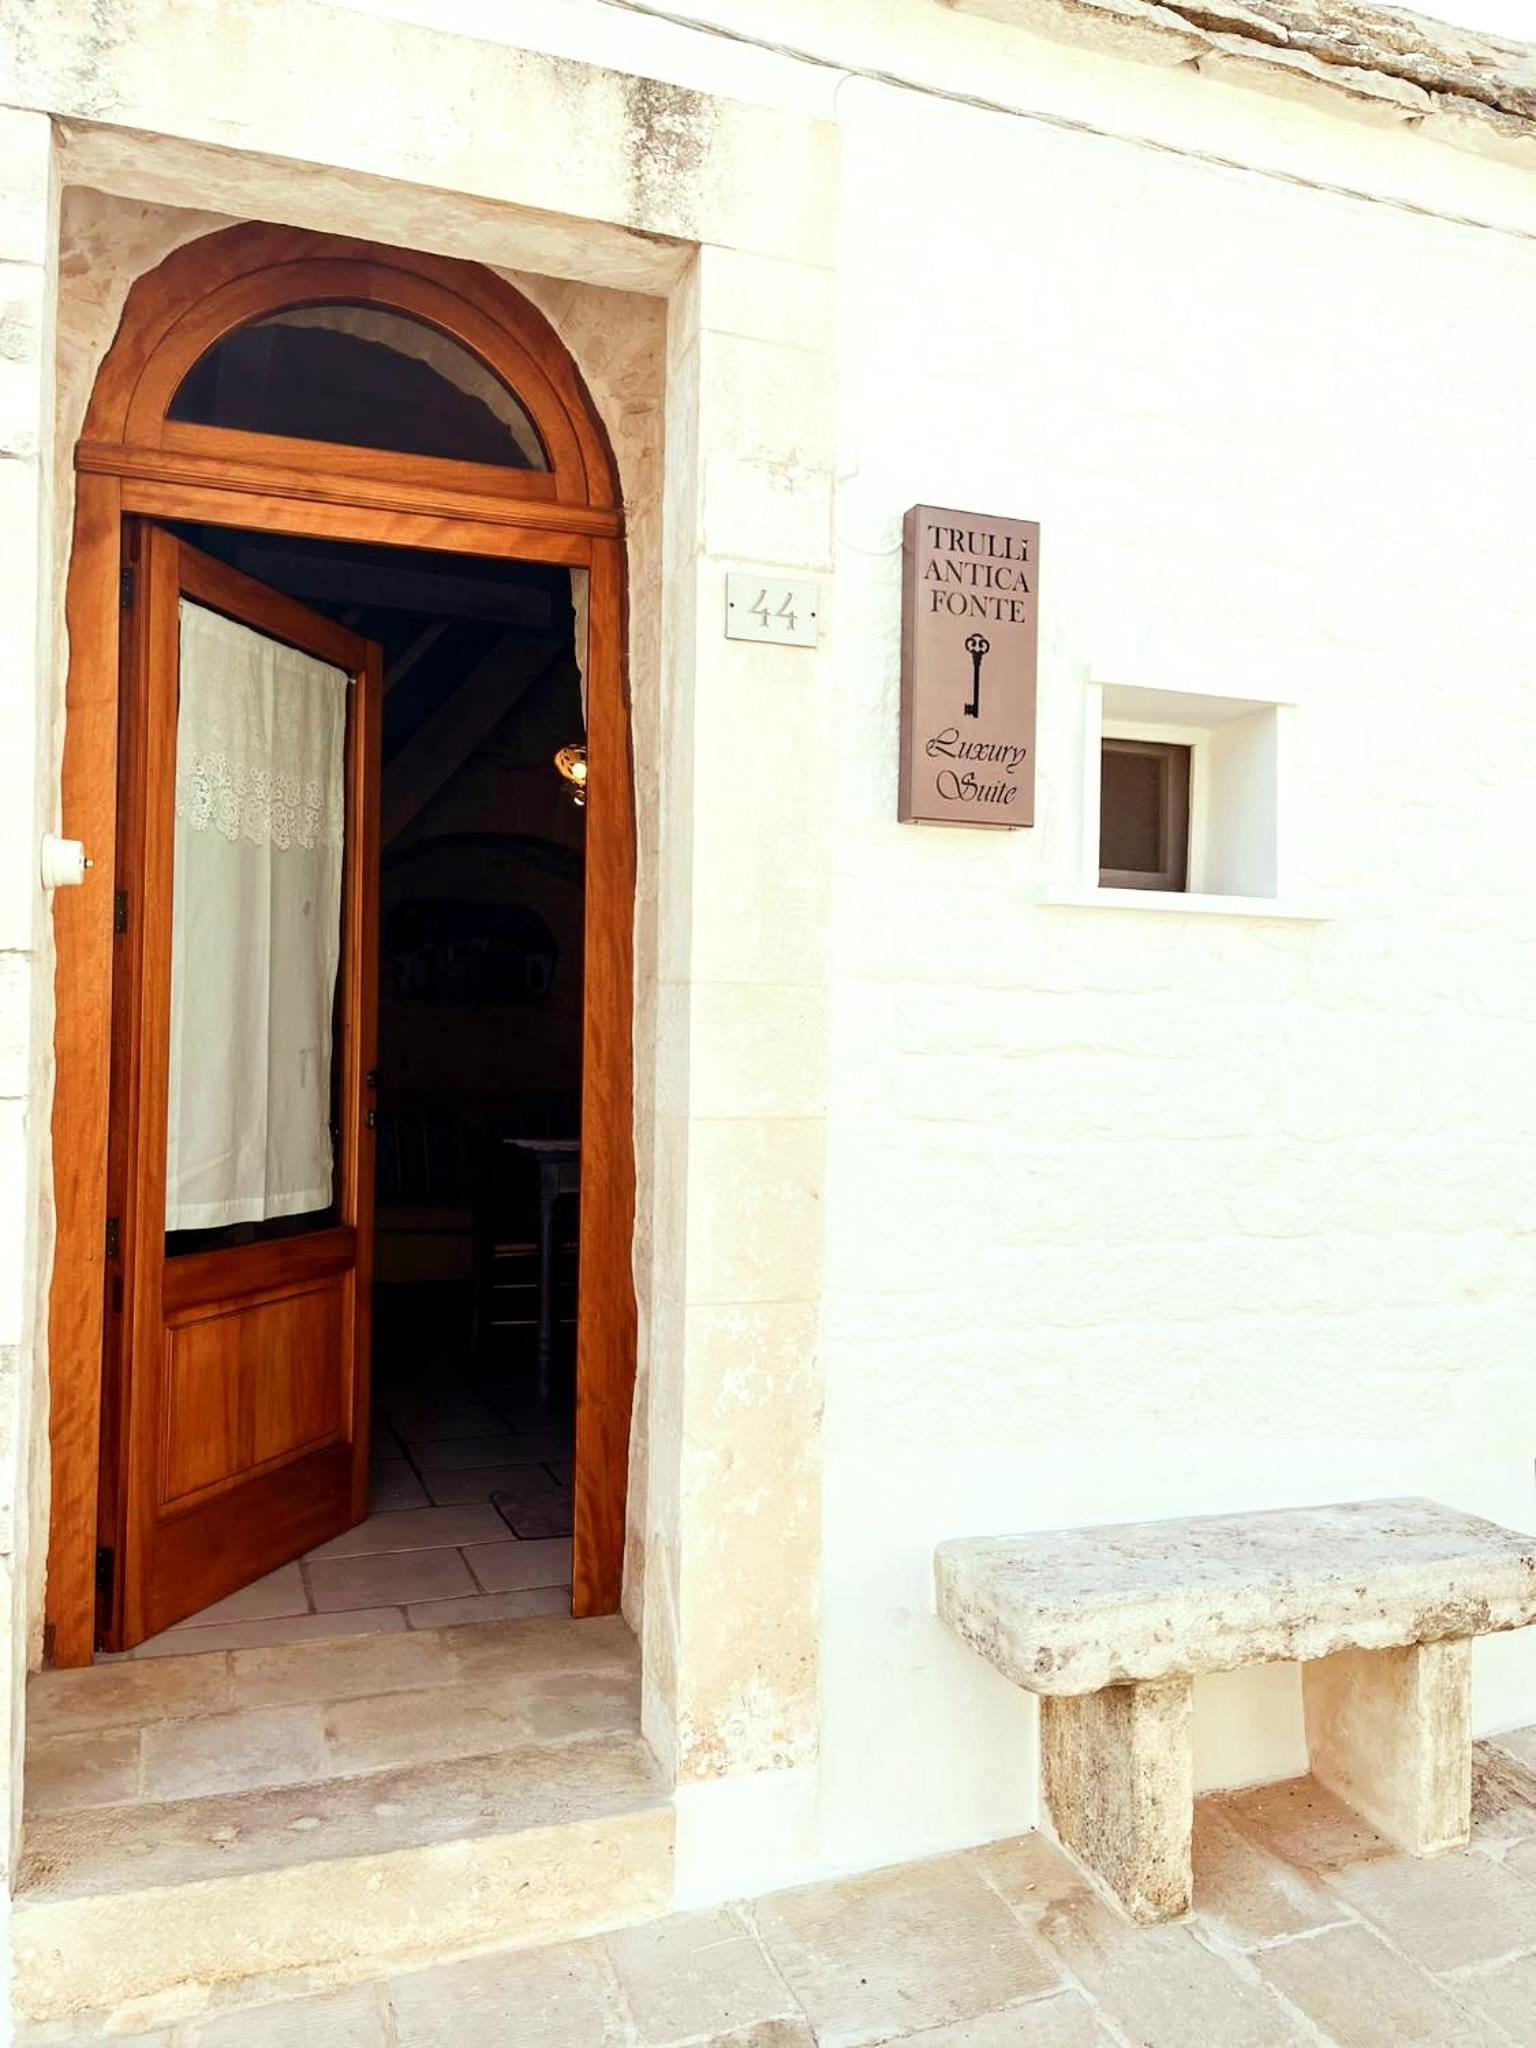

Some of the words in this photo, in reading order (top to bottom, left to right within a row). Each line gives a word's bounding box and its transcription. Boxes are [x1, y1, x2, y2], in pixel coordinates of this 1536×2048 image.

[924, 558, 1030, 594] ANTICA
[747, 589, 798, 631] 44
[931, 589, 1025, 624] FONTE
[925, 727, 1026, 774] Luxury
[936, 769, 1017, 805] Suite
